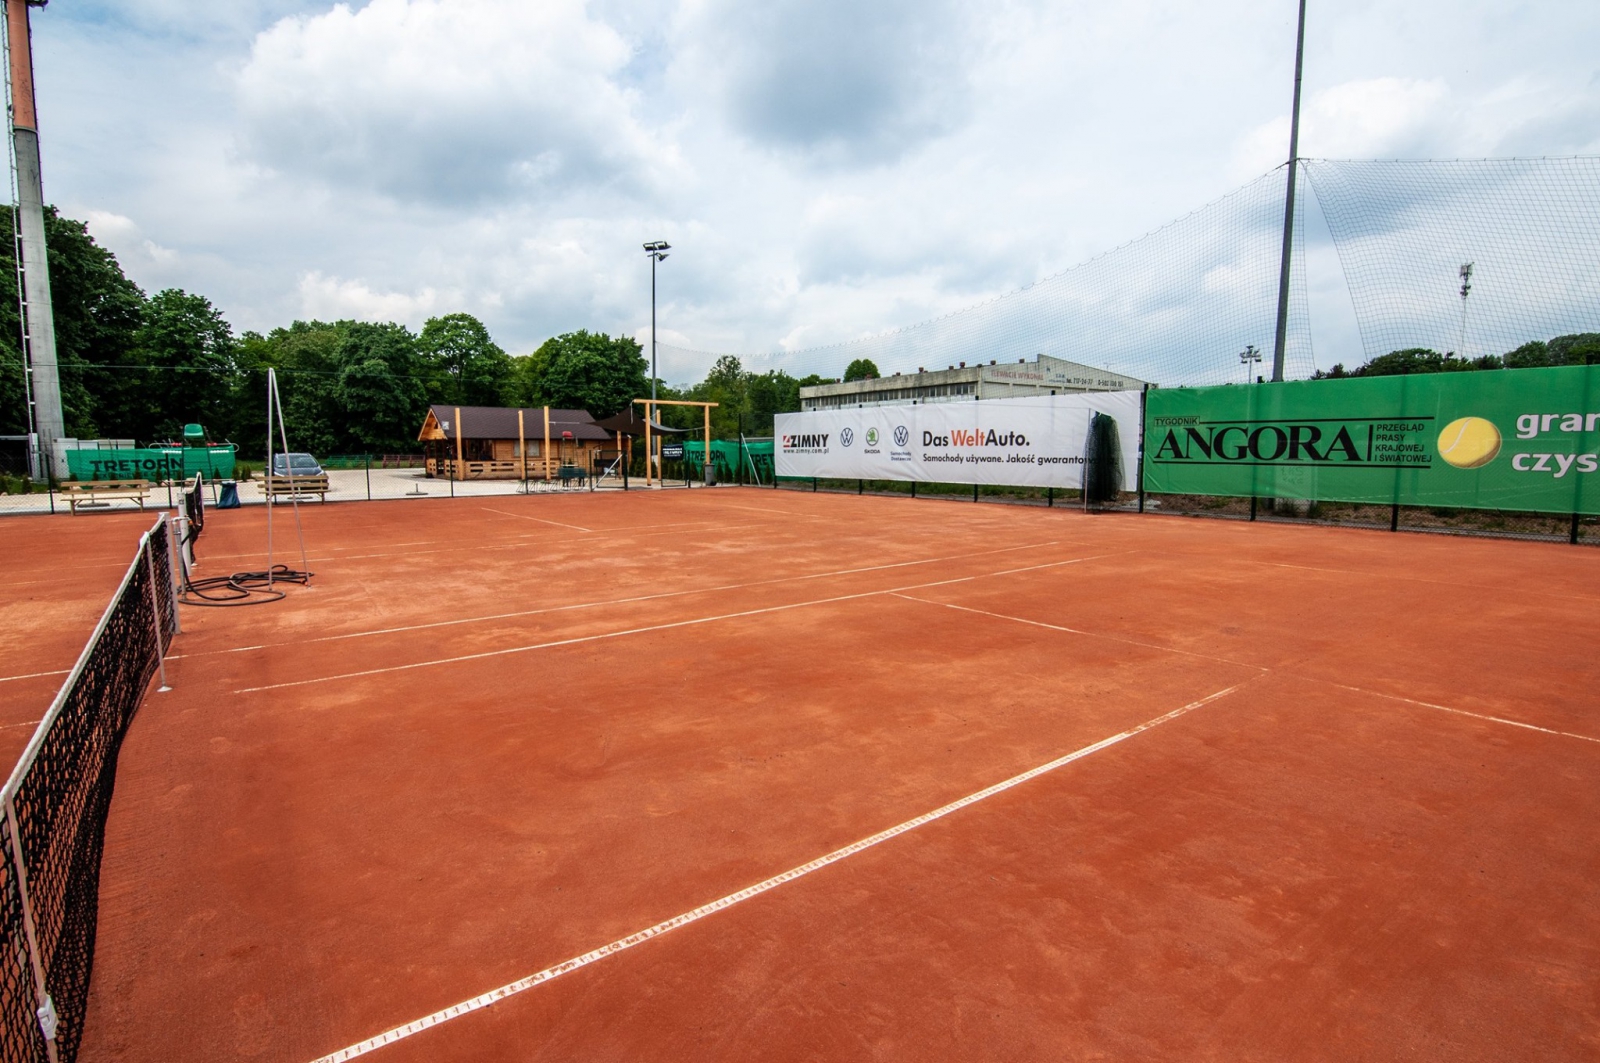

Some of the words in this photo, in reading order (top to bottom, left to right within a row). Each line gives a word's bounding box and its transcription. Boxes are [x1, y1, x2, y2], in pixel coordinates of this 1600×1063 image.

[1155, 417, 1197, 426] TYGODNIK
[1376, 423, 1425, 433] PRZEGLĄD
[790, 434, 829, 448] ZIMNY
[923, 430, 948, 447] Das
[951, 428, 1030, 447] WeltAuto.
[1376, 434, 1405, 442] PRASY
[1154, 425, 1364, 462] ANGORA
[1375, 443, 1425, 452] KRAJOWEJ
[691, 450, 726, 461] TREORN
[750, 453, 775, 464] TRET
[923, 453, 964, 465] Samochody
[965, 453, 1004, 465] używane.
[1006, 453, 1036, 465] Jakość
[1037, 455, 1090, 466] gwaranto
[1379, 453, 1432, 463] ŚWIATOWEJ
[89, 458, 183, 471] TRETORN
